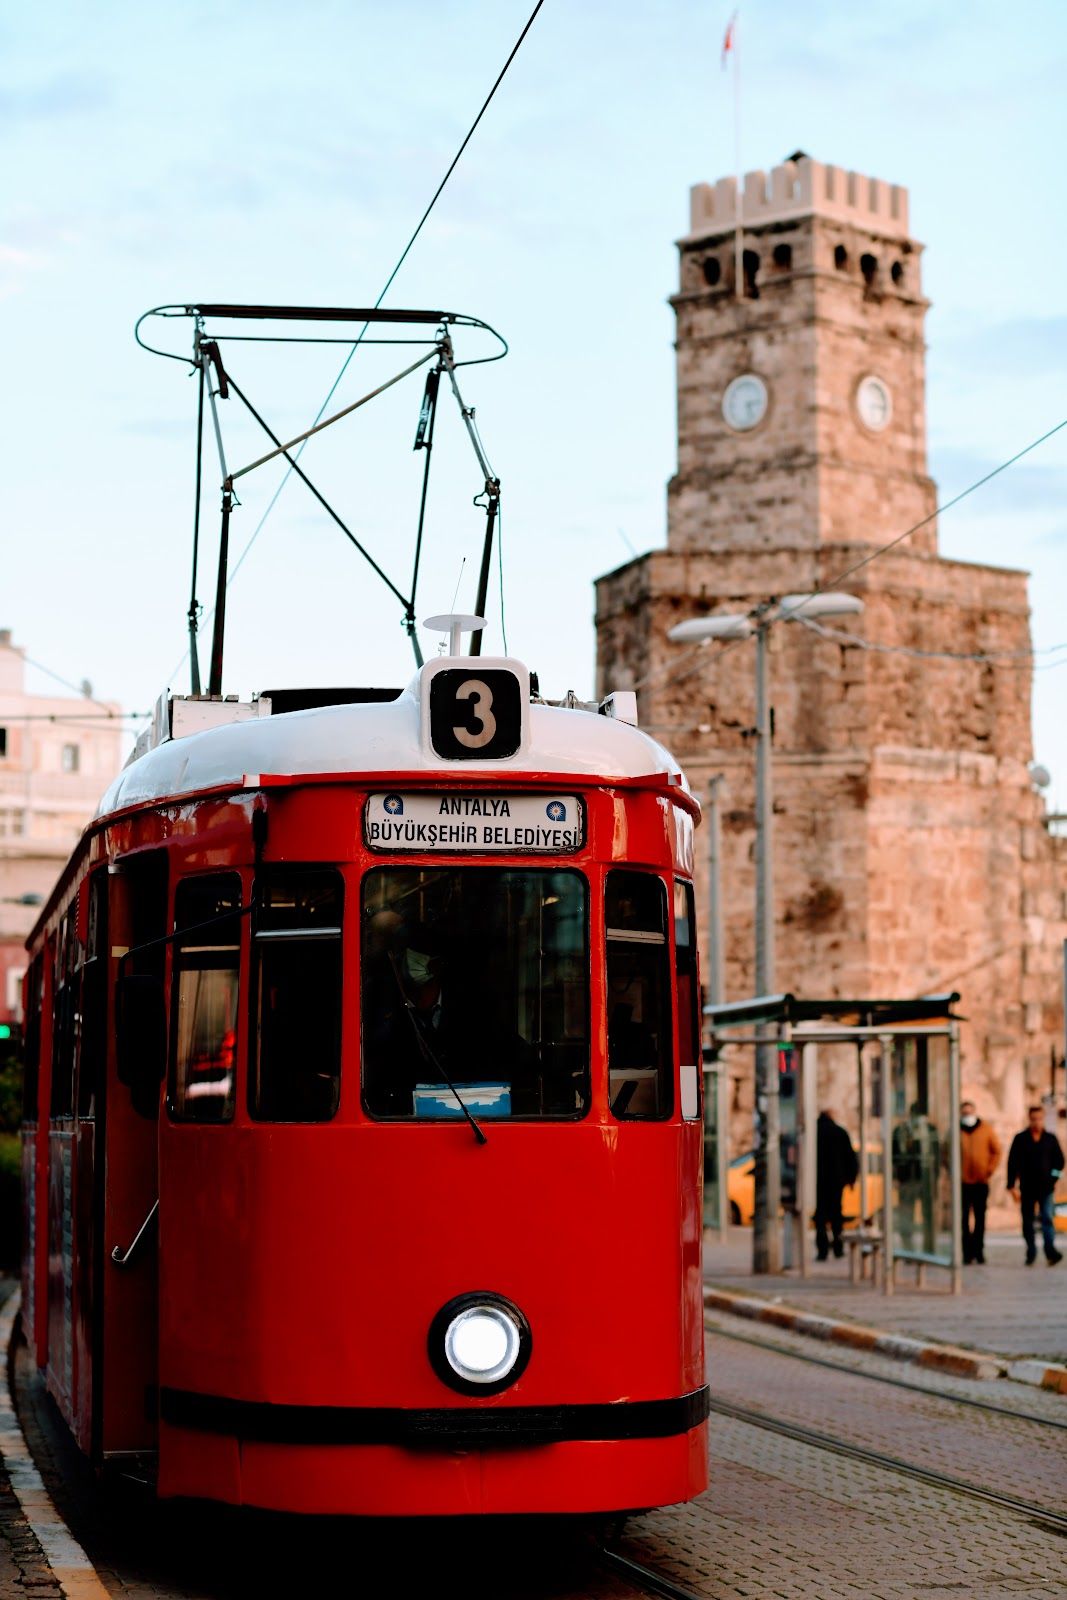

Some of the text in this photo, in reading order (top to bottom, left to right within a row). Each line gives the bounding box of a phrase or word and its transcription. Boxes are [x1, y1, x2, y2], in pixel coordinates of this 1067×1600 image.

[453, 680, 496, 748] 3
[439, 798, 511, 817] ANTALYA
[371, 819, 578, 847] BÜYÜKŞEHİR BELEDİYESİ
